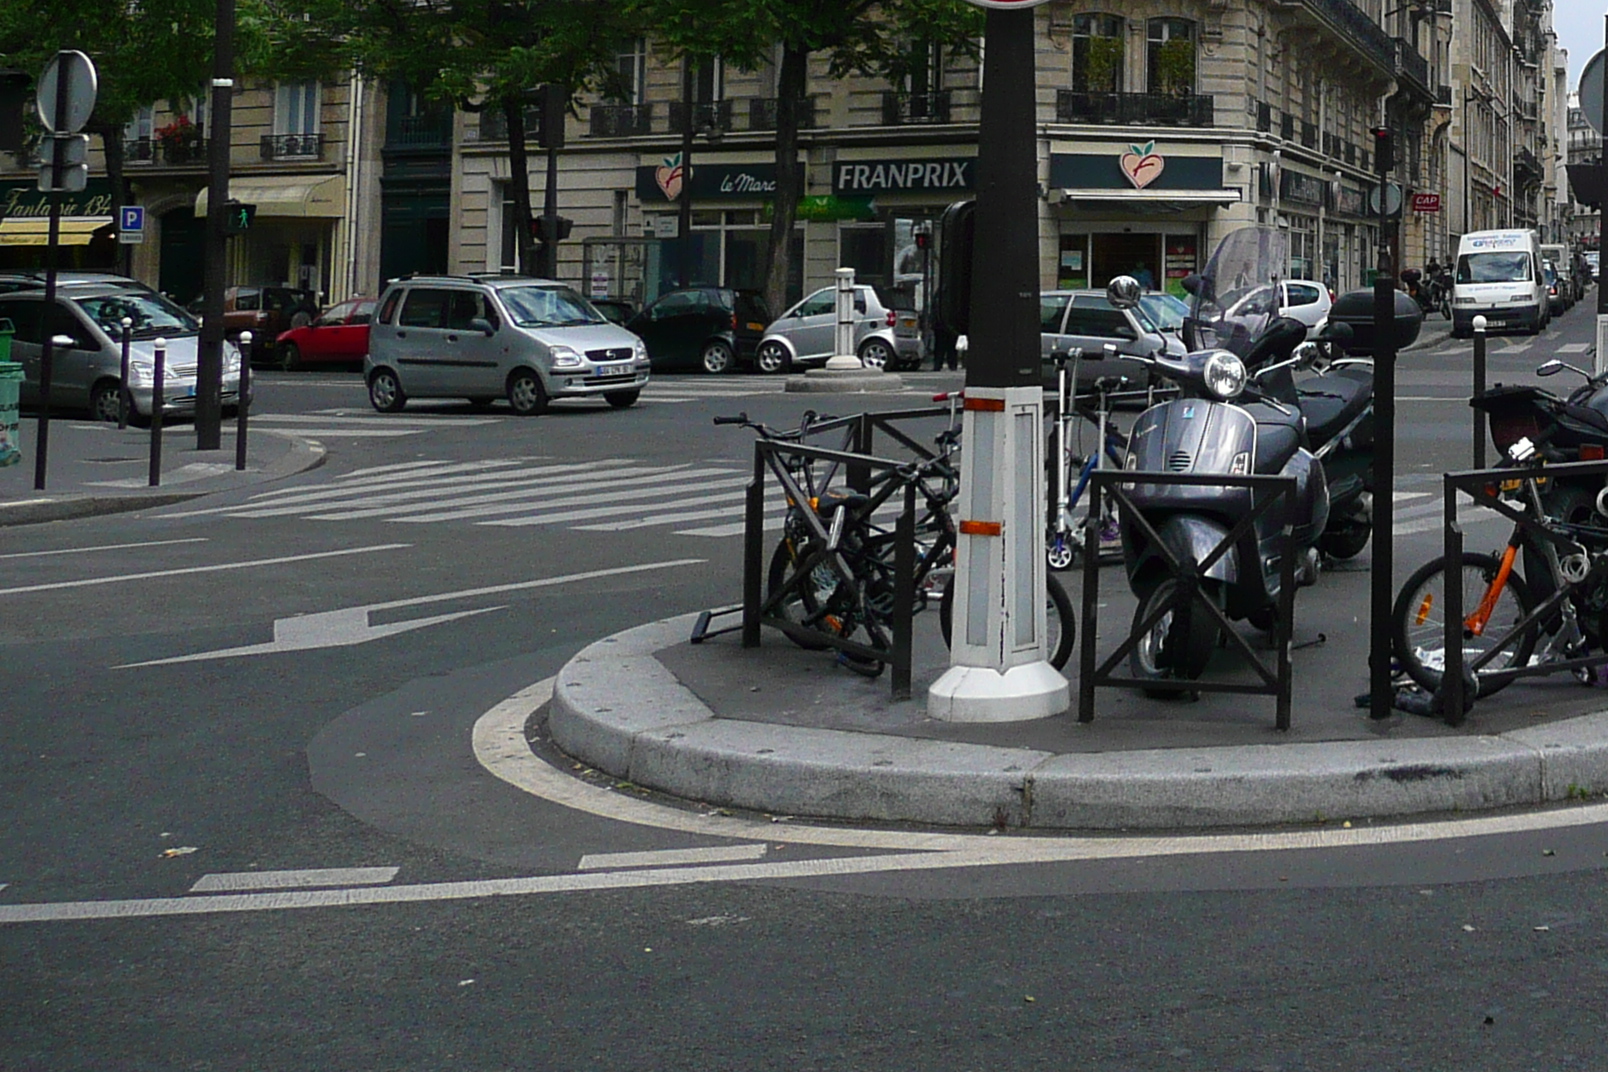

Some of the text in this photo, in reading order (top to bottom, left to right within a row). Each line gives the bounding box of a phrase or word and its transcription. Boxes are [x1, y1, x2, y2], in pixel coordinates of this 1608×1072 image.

[734, 173, 776, 191] Marc
[838, 162, 968, 189] FRANPRIX
[1416, 196, 1438, 205] CAP
